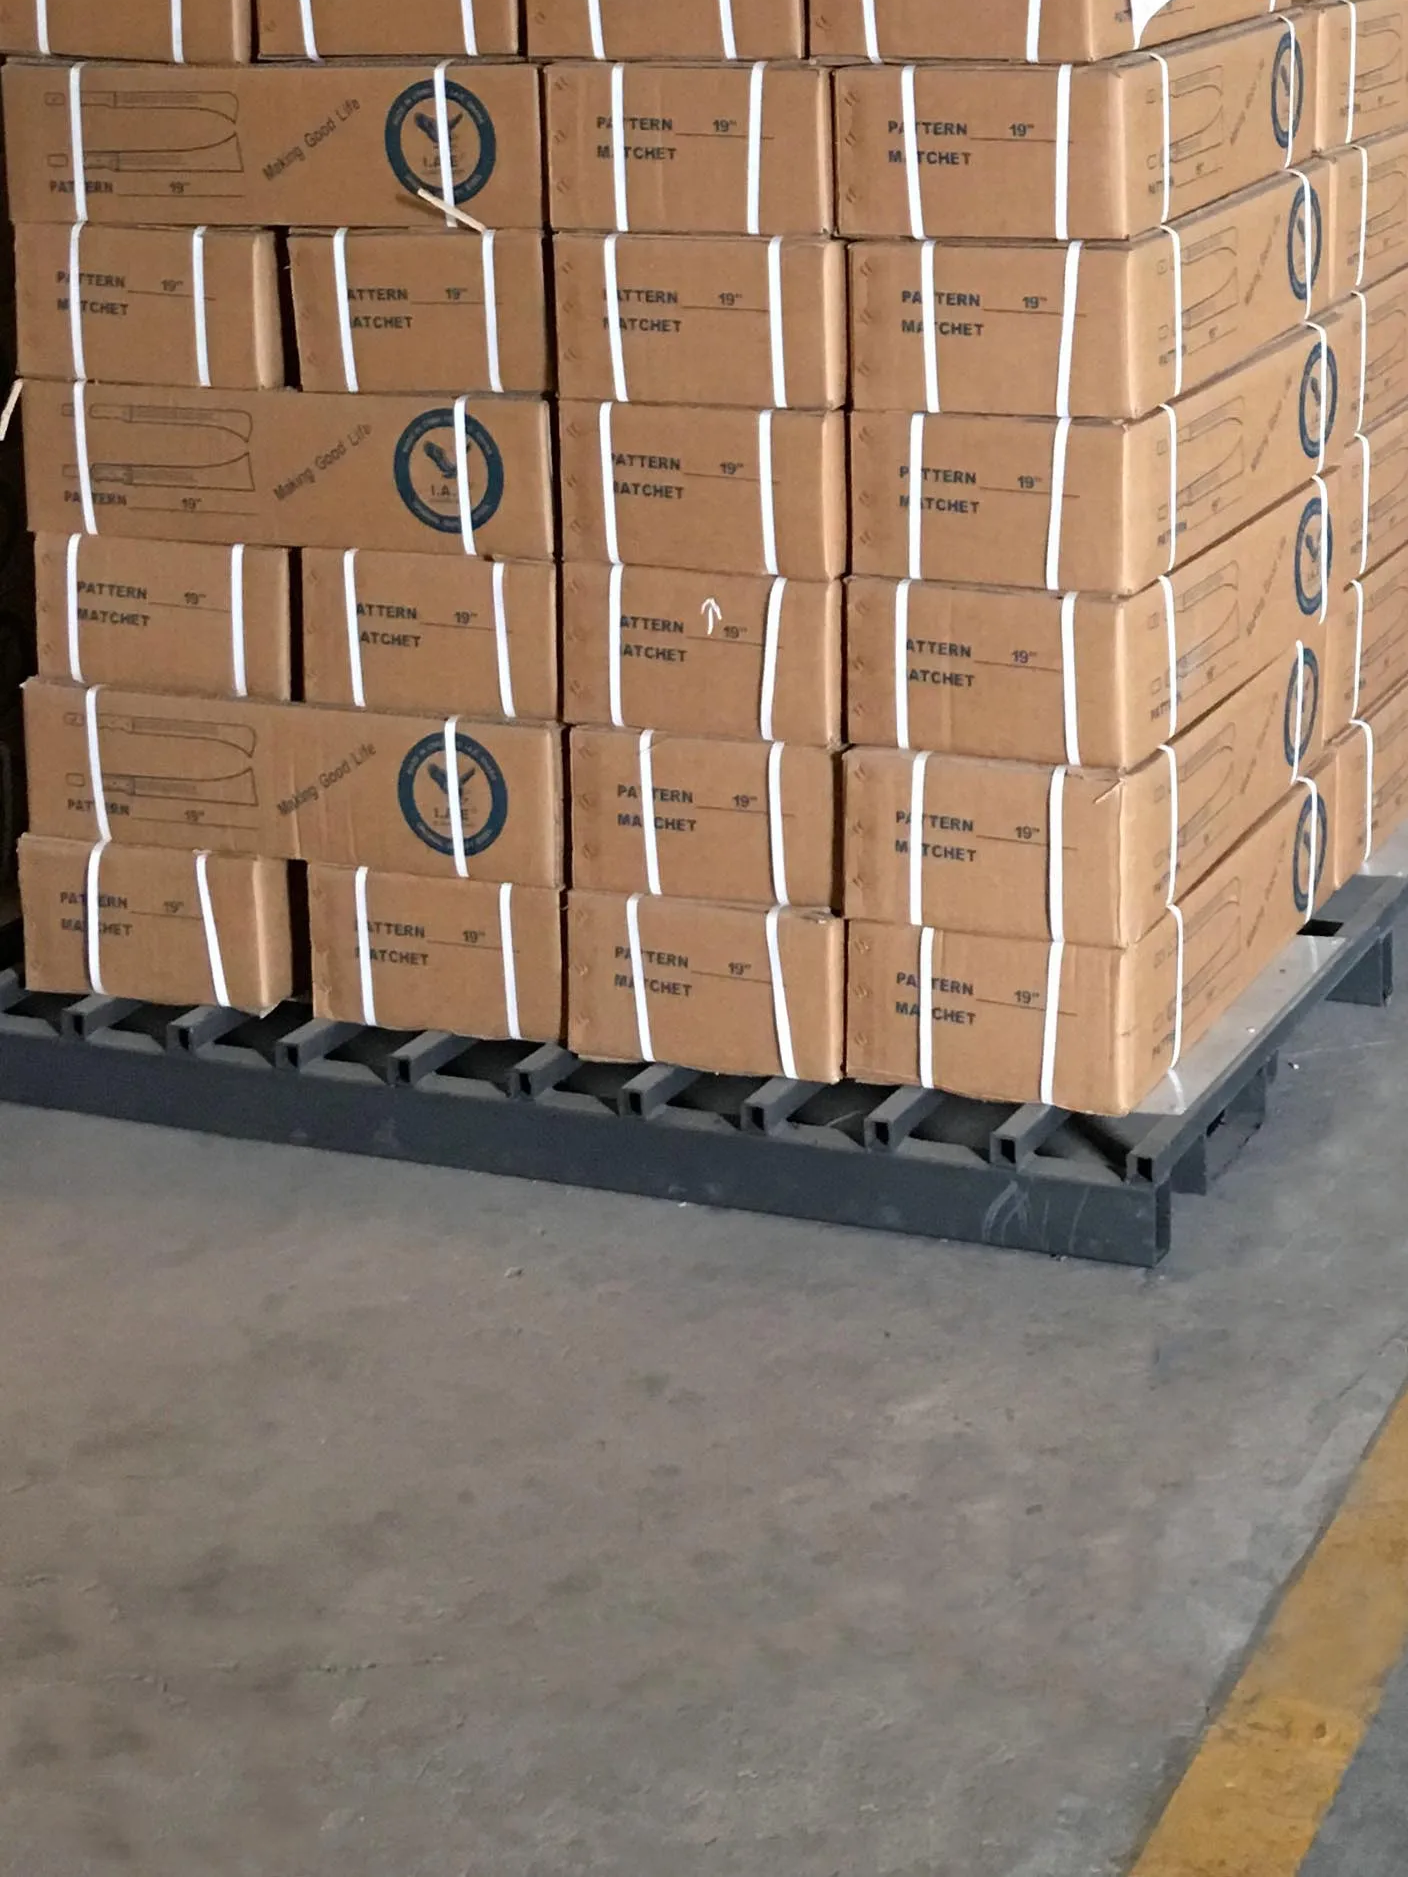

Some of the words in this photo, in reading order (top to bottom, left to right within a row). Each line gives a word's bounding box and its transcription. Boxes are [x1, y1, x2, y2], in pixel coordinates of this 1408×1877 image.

[596, 117, 673, 132] PTERN
[888, 120, 968, 136] PTERN
[262, 144, 307, 181] Making
[303, 116, 339, 150] Good
[336, 95, 362, 124] Life
[596, 145, 677, 160] MTCHET
[888, 150, 972, 165] MTCHET
[49, 180, 114, 194] PATERN
[55, 271, 126, 287] PTTERN
[347, 288, 409, 301] ATTERN
[603, 289, 678, 304] ATTERN
[901, 290, 981, 307] PATERN
[56, 299, 129, 315] MTCHET
[349, 315, 413, 329] ATCHET
[901, 320, 984, 337] MACHET
[273, 468, 316, 502] Making
[313, 441, 348, 474] Good
[348, 421, 374, 450] Life
[899, 465, 976, 484] PTTERN
[63, 491, 127, 507] PATERN
[899, 495, 980, 515] MTCHET
[77, 580, 148, 600] PATTERN
[77, 607, 151, 627] MATCHET
[355, 603, 418, 620] ATTERN
[620, 615, 685, 634] ATTERN
[359, 630, 421, 648] ATCHET
[905, 638, 972, 659] ATTERN
[620, 644, 688, 663] ATCHET
[906, 668, 976, 688] ATCHET
[276, 782, 320, 818] Making
[318, 760, 353, 792] Good
[350, 741, 378, 768] Life
[616, 784, 694, 804] PATERN
[67, 798, 130, 816] PATERN
[617, 812, 697, 832] MACHET
[895, 809, 974, 833] PTERN
[894, 839, 977, 863] MTCHET
[59, 891, 128, 909] PATERN
[60, 918, 133, 936] MAHET
[355, 920, 426, 939] ATTERN
[355, 947, 429, 966] ATCHET
[614, 945, 689, 969] PATERN
[896, 972, 974, 997] PATERN
[895, 1001, 977, 1025] MACHET
